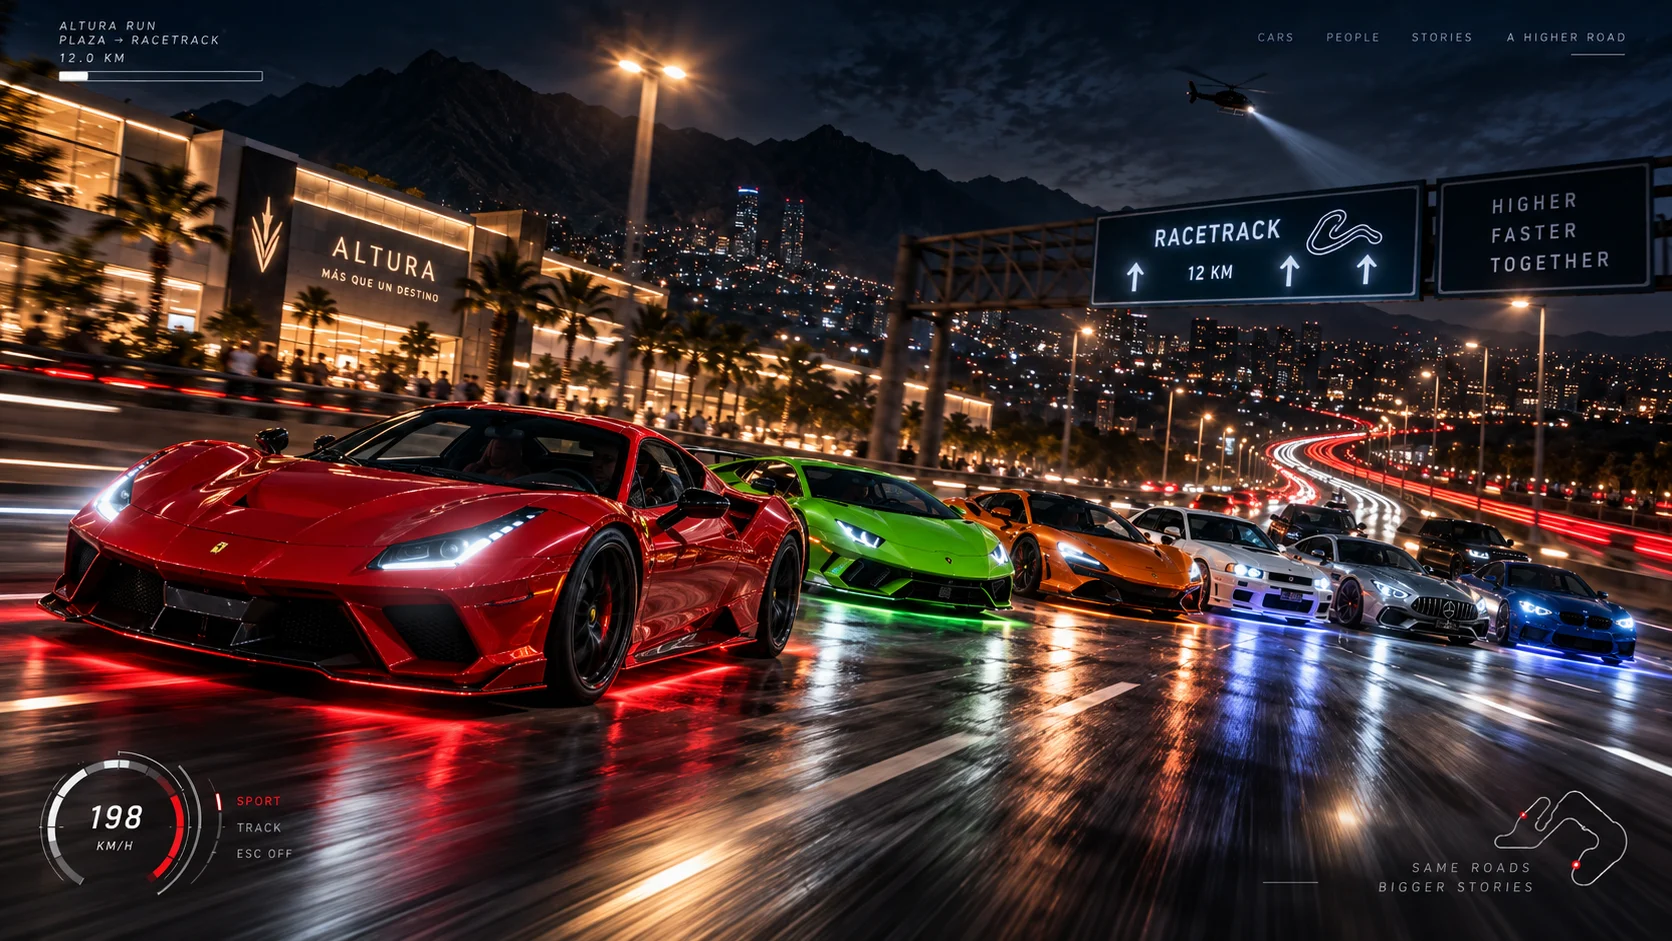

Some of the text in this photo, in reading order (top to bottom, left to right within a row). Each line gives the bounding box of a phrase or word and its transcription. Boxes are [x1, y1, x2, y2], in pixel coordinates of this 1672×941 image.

[1492, 192, 1576, 214] HIGHER
[1154, 218, 1281, 248] RACETRACK
[1491, 222, 1576, 244] FASTER
[331, 236, 435, 282] ALTURA
[1490, 251, 1609, 273] TOGETHER
[1188, 264, 1233, 281] 12 KM
[321, 268, 439, 303] MÁS QUE UN DESTINO
